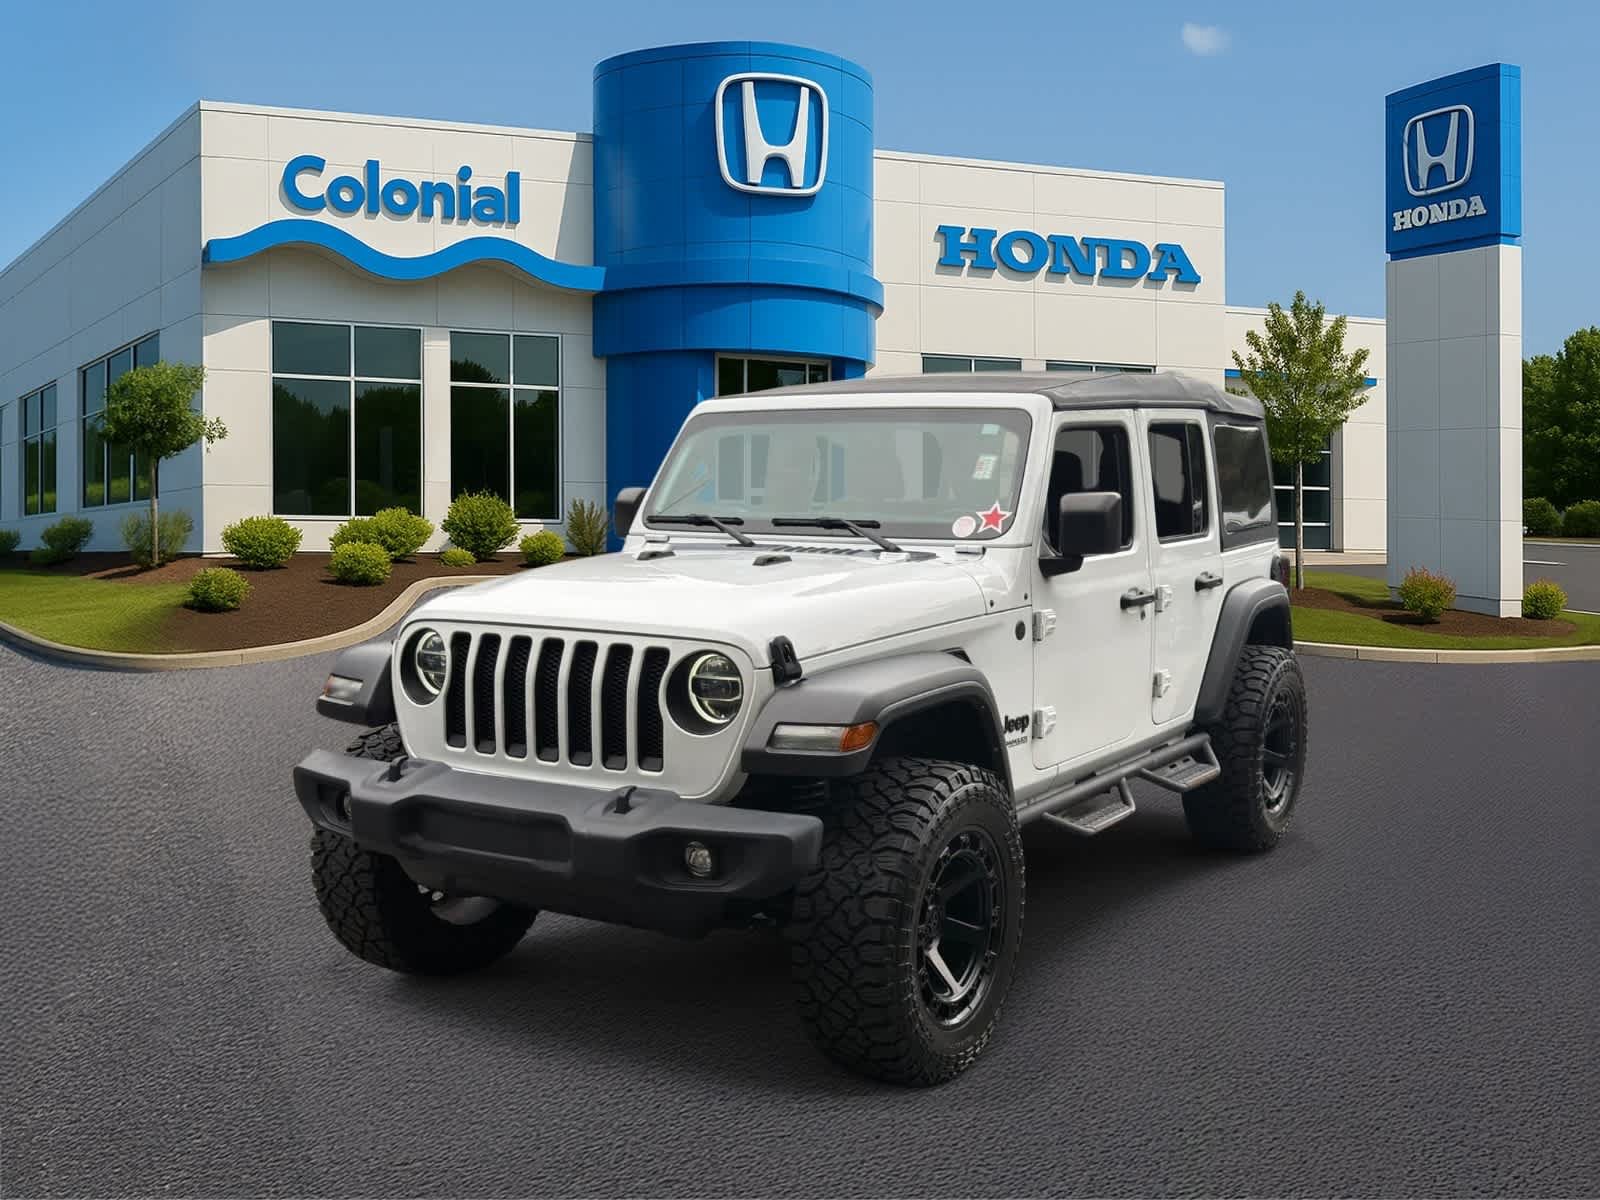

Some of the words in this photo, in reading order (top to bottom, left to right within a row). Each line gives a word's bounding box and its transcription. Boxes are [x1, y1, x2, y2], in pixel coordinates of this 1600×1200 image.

[281, 154, 521, 226] Colonial
[1392, 195, 1486, 231] HONDA
[937, 225, 1201, 284] HONDA
